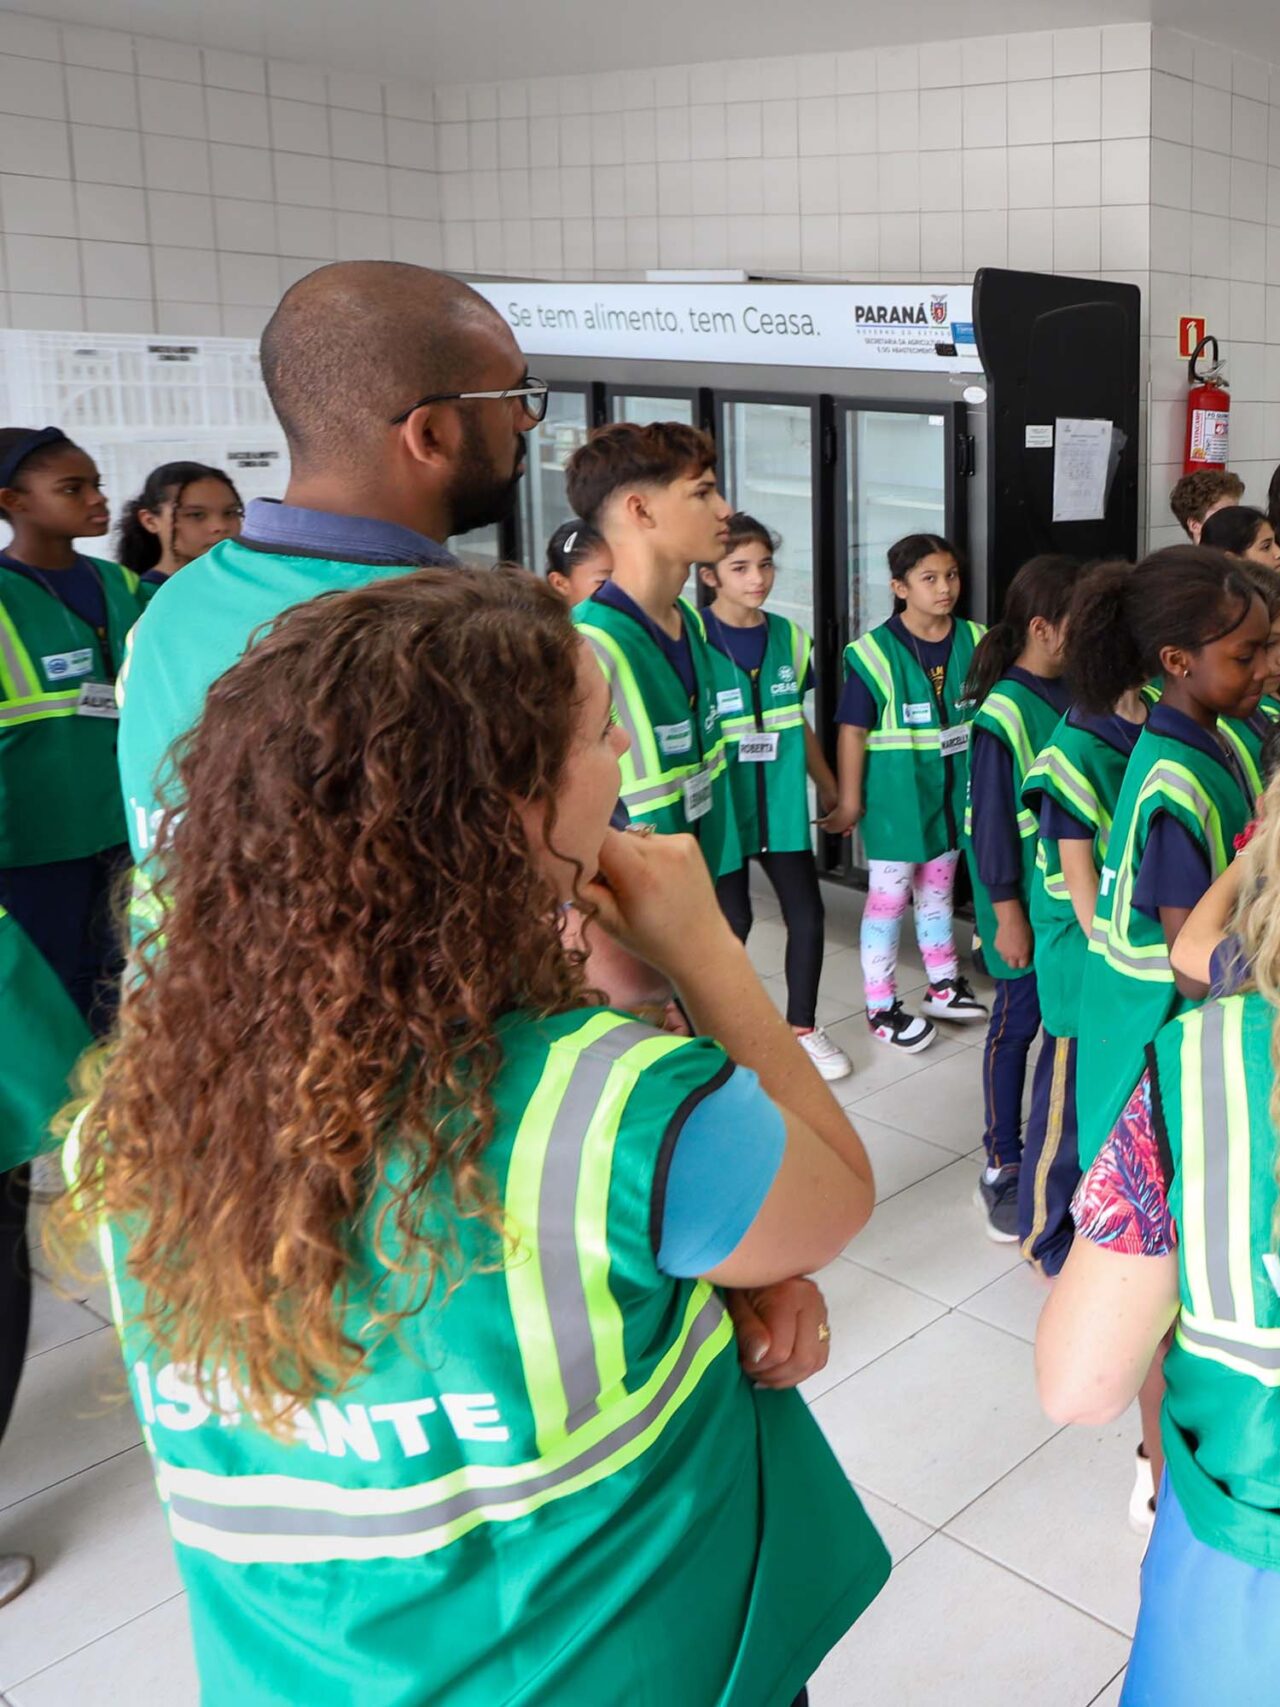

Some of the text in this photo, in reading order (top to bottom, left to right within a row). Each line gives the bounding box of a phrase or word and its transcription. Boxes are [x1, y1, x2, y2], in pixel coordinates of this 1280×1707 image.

[508, 302, 820, 336] Se tem alimento, tem Ceasa.
[855, 303, 928, 324] PARANÁ
